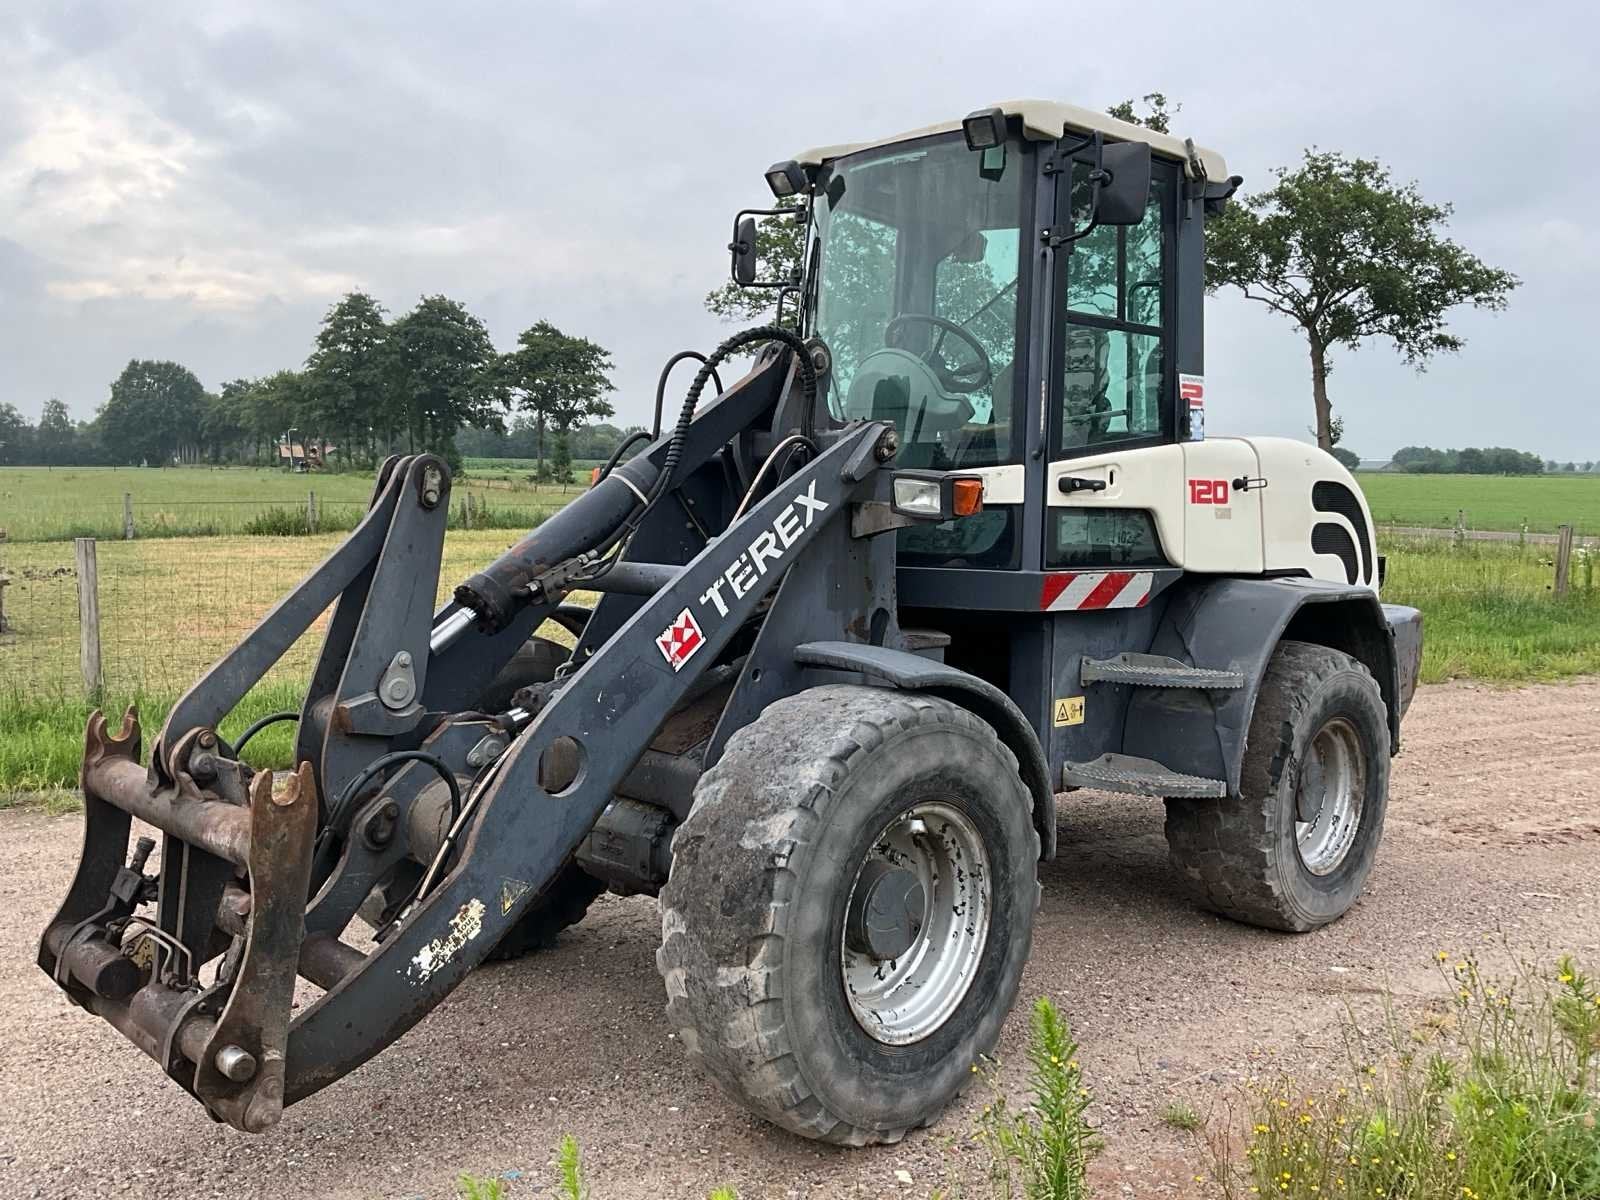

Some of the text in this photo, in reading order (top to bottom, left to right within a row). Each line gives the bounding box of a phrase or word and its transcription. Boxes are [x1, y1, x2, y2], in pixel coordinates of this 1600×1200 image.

[1182, 383, 1203, 406] 2
[1188, 480, 1228, 504] 120
[699, 479, 829, 618] TEREX
